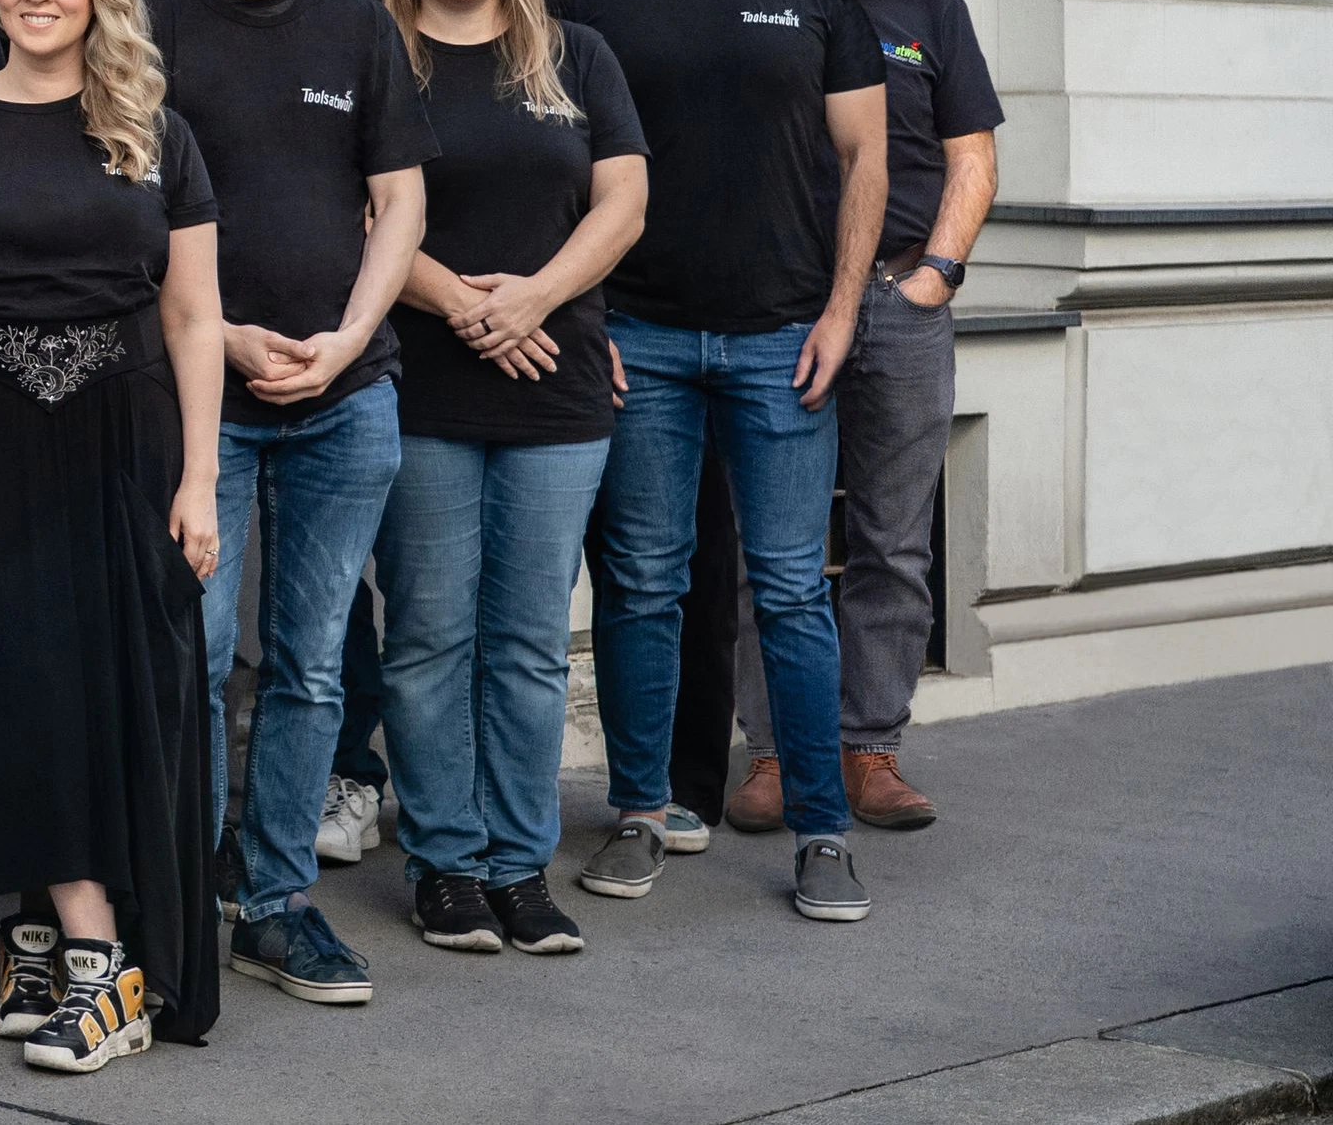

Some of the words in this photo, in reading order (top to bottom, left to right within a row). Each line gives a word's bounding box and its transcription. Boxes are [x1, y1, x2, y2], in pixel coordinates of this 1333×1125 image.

[740, 11, 800, 28] Toolsatwork
[301, 88, 354, 113] Toolsatwor
[21, 930, 50, 943] NIKE
[70, 955, 98, 969] NIKE
